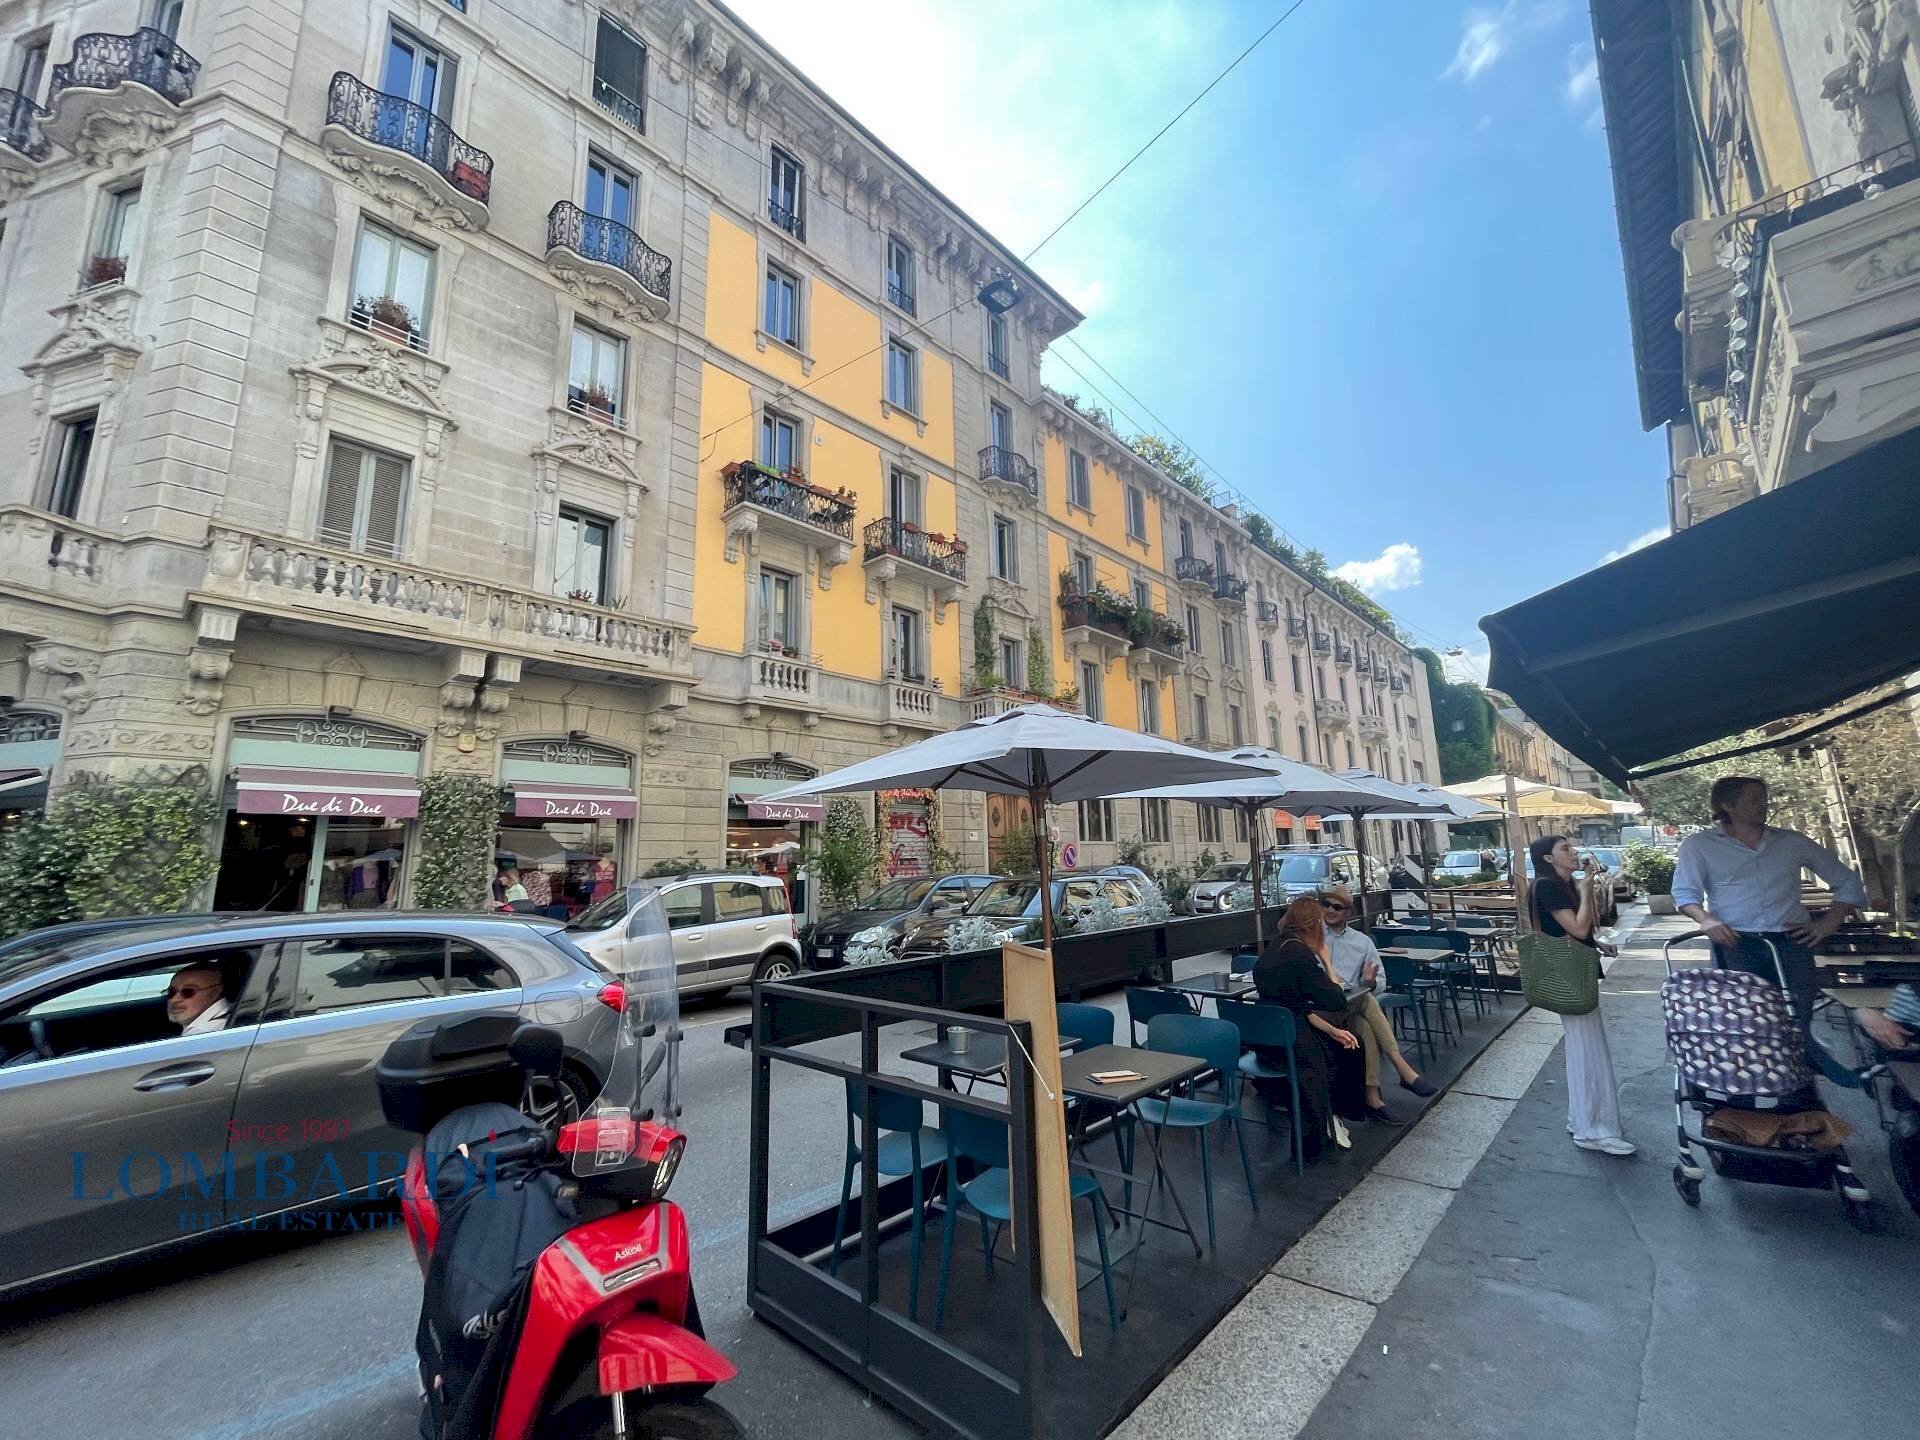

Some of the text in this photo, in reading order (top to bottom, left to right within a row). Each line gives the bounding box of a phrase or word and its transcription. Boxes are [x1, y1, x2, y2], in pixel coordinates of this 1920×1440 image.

[282, 793, 382, 815] Due di Due
[545, 800, 612, 817] Due di Due
[765, 805, 809, 820] Due di Due
[614, 1243, 642, 1262] Askoll
